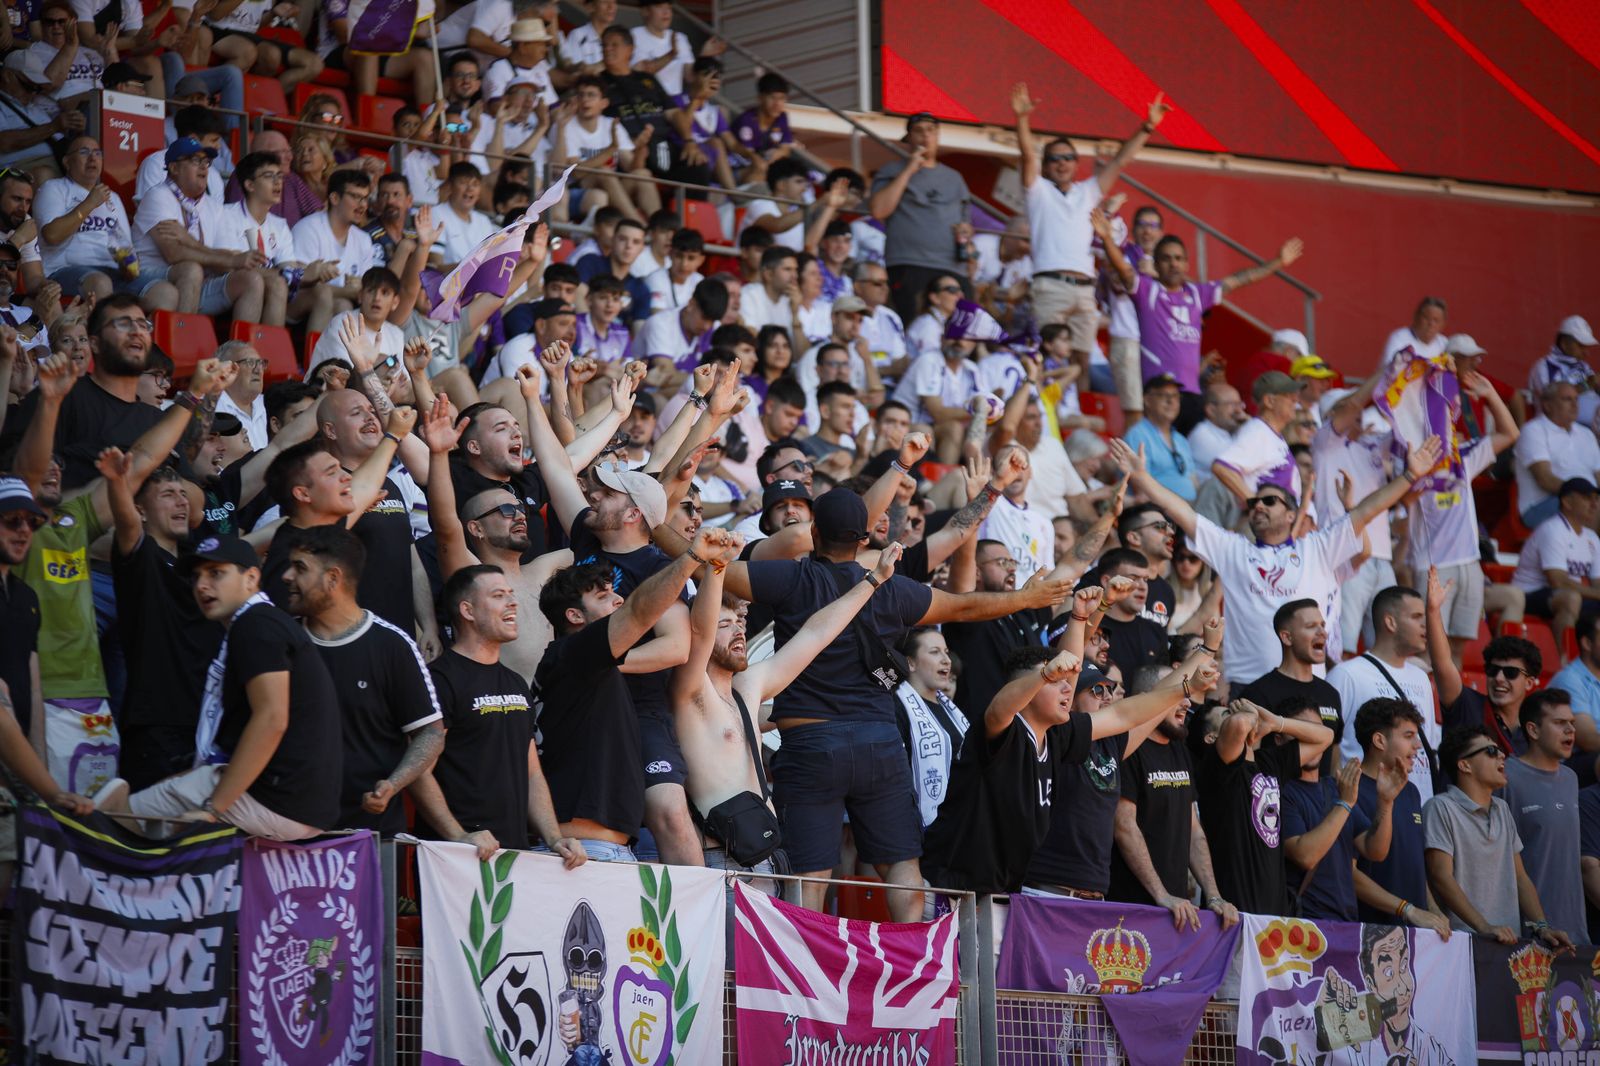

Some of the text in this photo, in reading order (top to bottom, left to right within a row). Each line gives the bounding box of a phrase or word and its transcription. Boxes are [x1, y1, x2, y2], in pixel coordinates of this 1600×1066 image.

[109, 117, 133, 130] Sector
[119, 130, 139, 153] 21
[631, 989, 655, 1008] jaen
